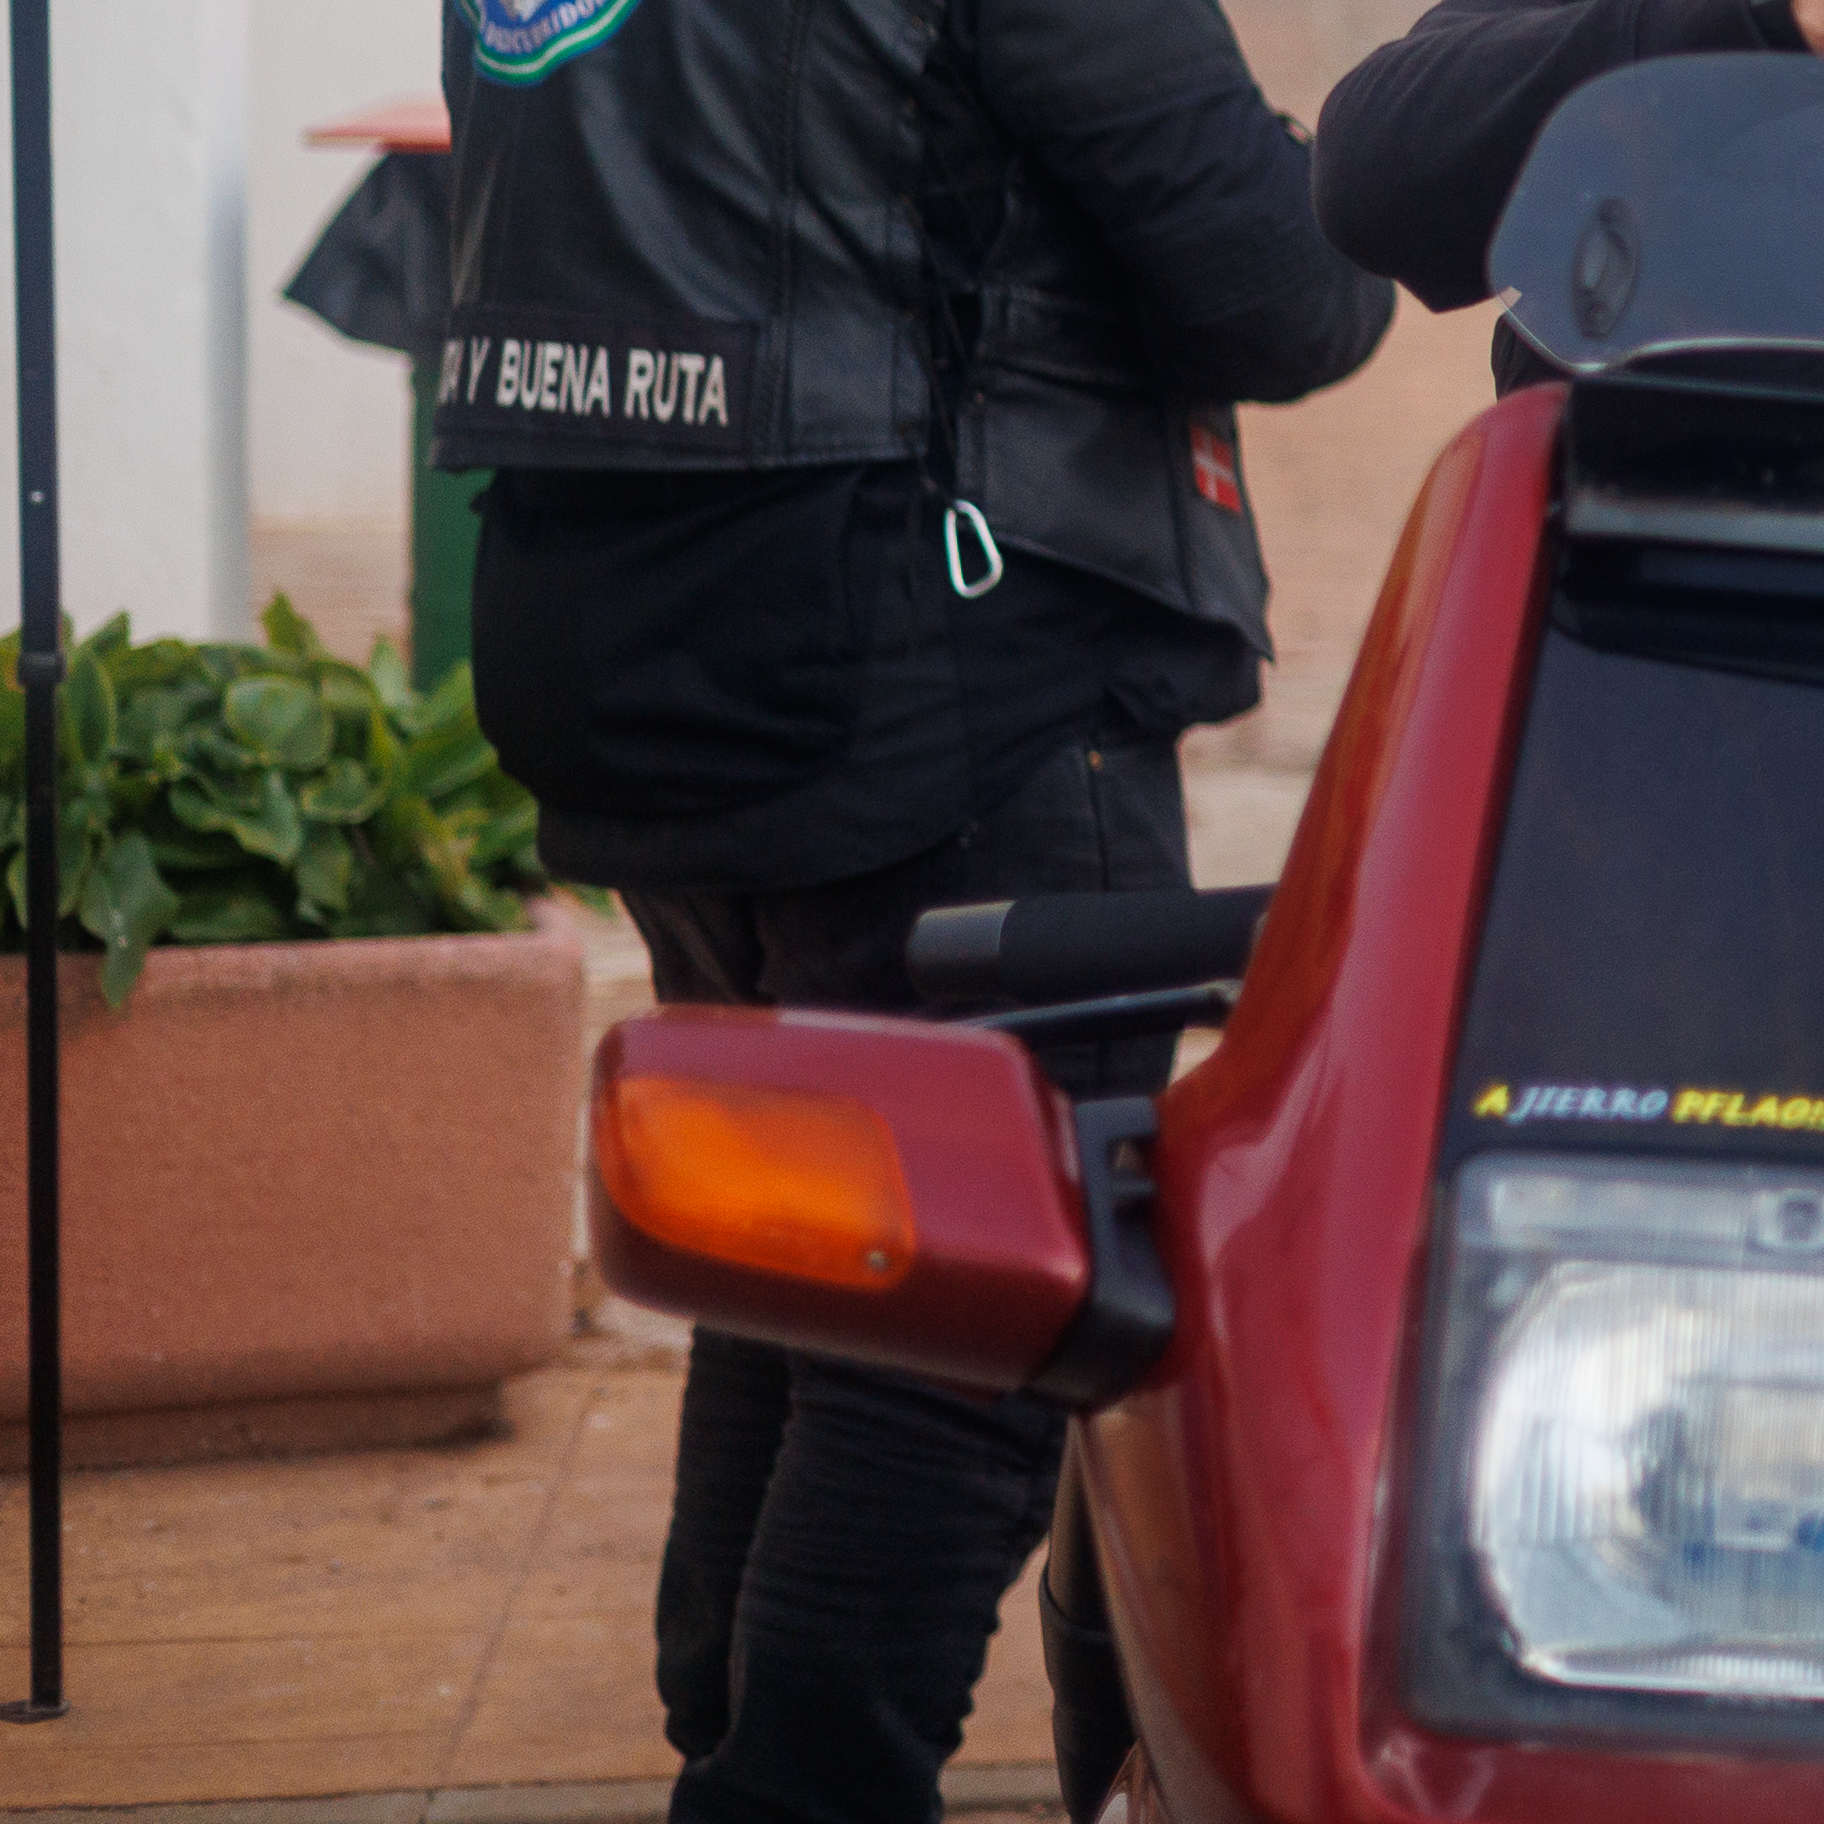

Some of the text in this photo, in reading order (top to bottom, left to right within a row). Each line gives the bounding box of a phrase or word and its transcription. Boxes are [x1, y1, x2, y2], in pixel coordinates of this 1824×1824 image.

[467, 336, 491, 405] Y
[497, 337, 612, 418] BUENA
[623, 347, 729, 427] RUTA
[1475, 1084, 1508, 1116] A
